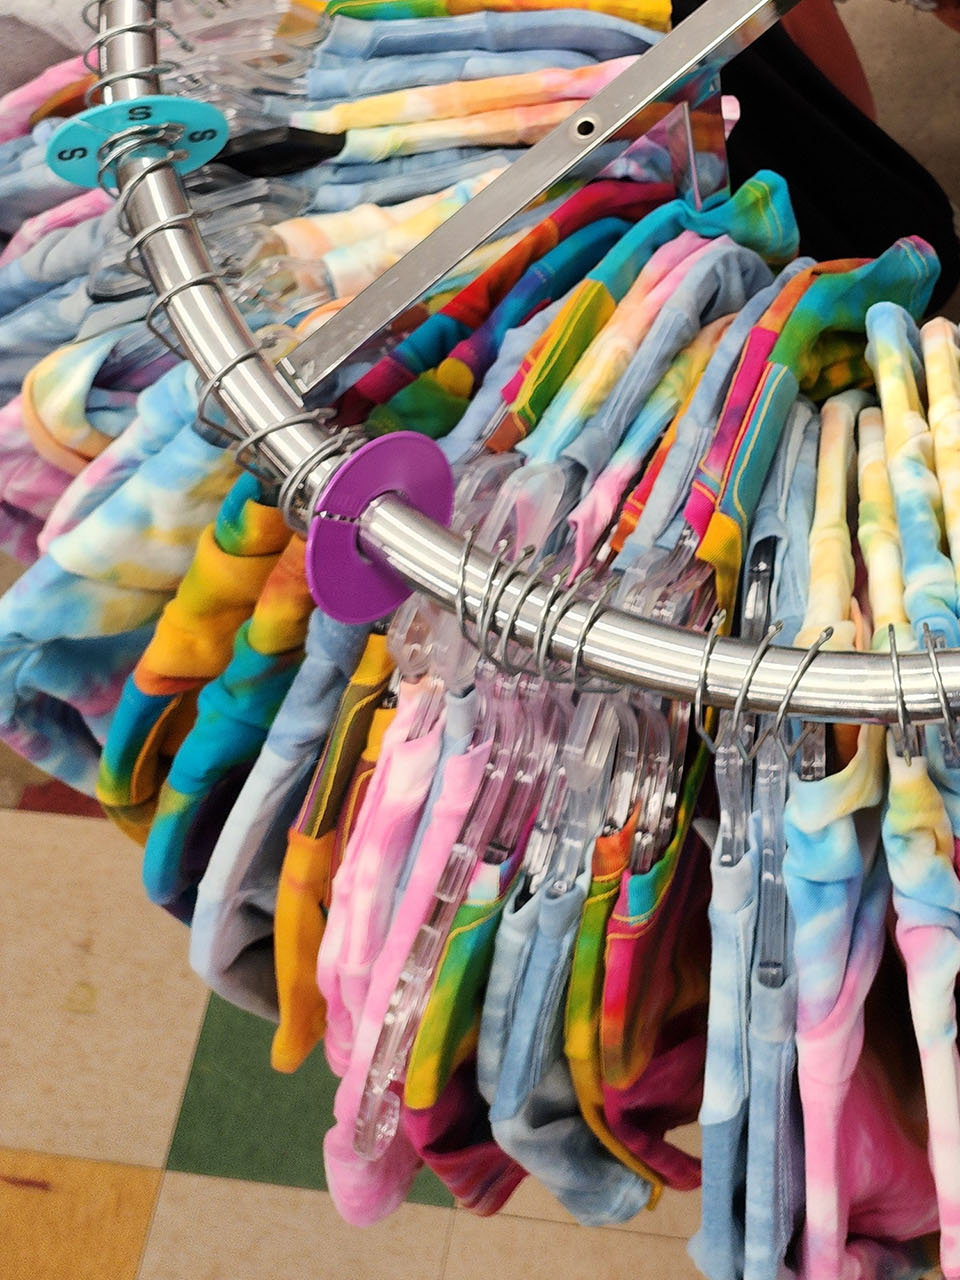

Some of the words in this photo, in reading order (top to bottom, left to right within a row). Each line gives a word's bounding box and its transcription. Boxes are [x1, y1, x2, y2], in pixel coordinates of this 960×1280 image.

[128, 105, 153, 121] S
[188, 128, 219, 143] S
[57, 146, 88, 162] S
